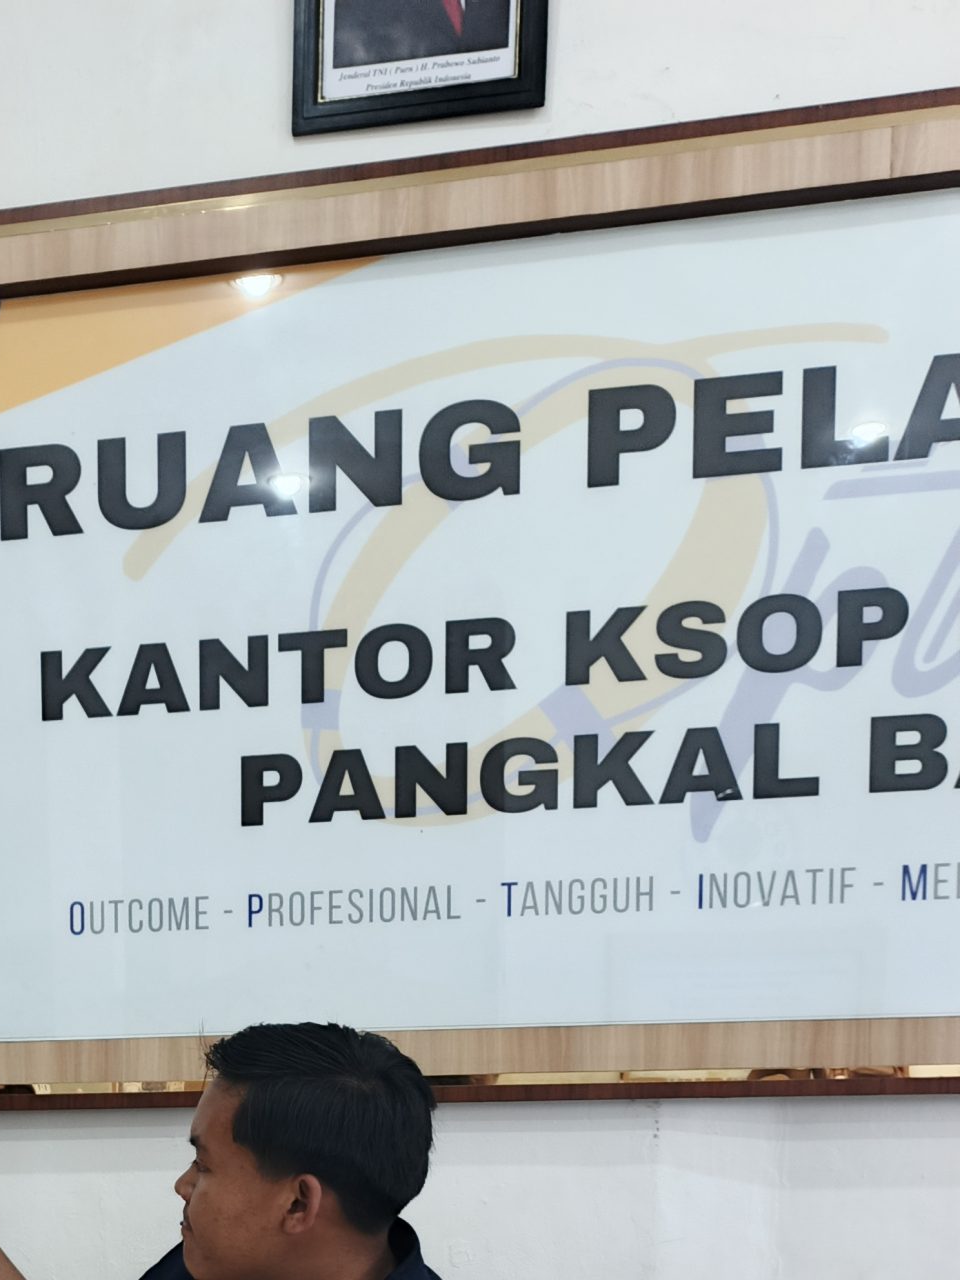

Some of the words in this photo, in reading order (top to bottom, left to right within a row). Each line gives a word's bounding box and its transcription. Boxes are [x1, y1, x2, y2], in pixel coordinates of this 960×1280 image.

[366, 82, 399, 92] Presiden
[400, 76, 432, 89] Republik
[435, 73, 471, 84] Indonesia
[373, 67, 388, 77] TNI
[432, 60, 465, 70] Prabowo
[467, 56, 501, 66] Subianto
[0, 399, 521, 542] RUANG
[587, 353, 960, 489] PELA
[40, 617, 517, 722] KANTOR
[565, 587, 909, 686] KSOP
[240, 723, 820, 827] PANGKAL
[868, 713, 960, 794] B
[69, 895, 210, 936] OUTCOME
[247, 884, 462, 930] PROFESIONAL
[500, 875, 654, 918] TANGGUH
[697, 866, 858, 910] INOVATIF
[900, 862, 960, 902] ME
